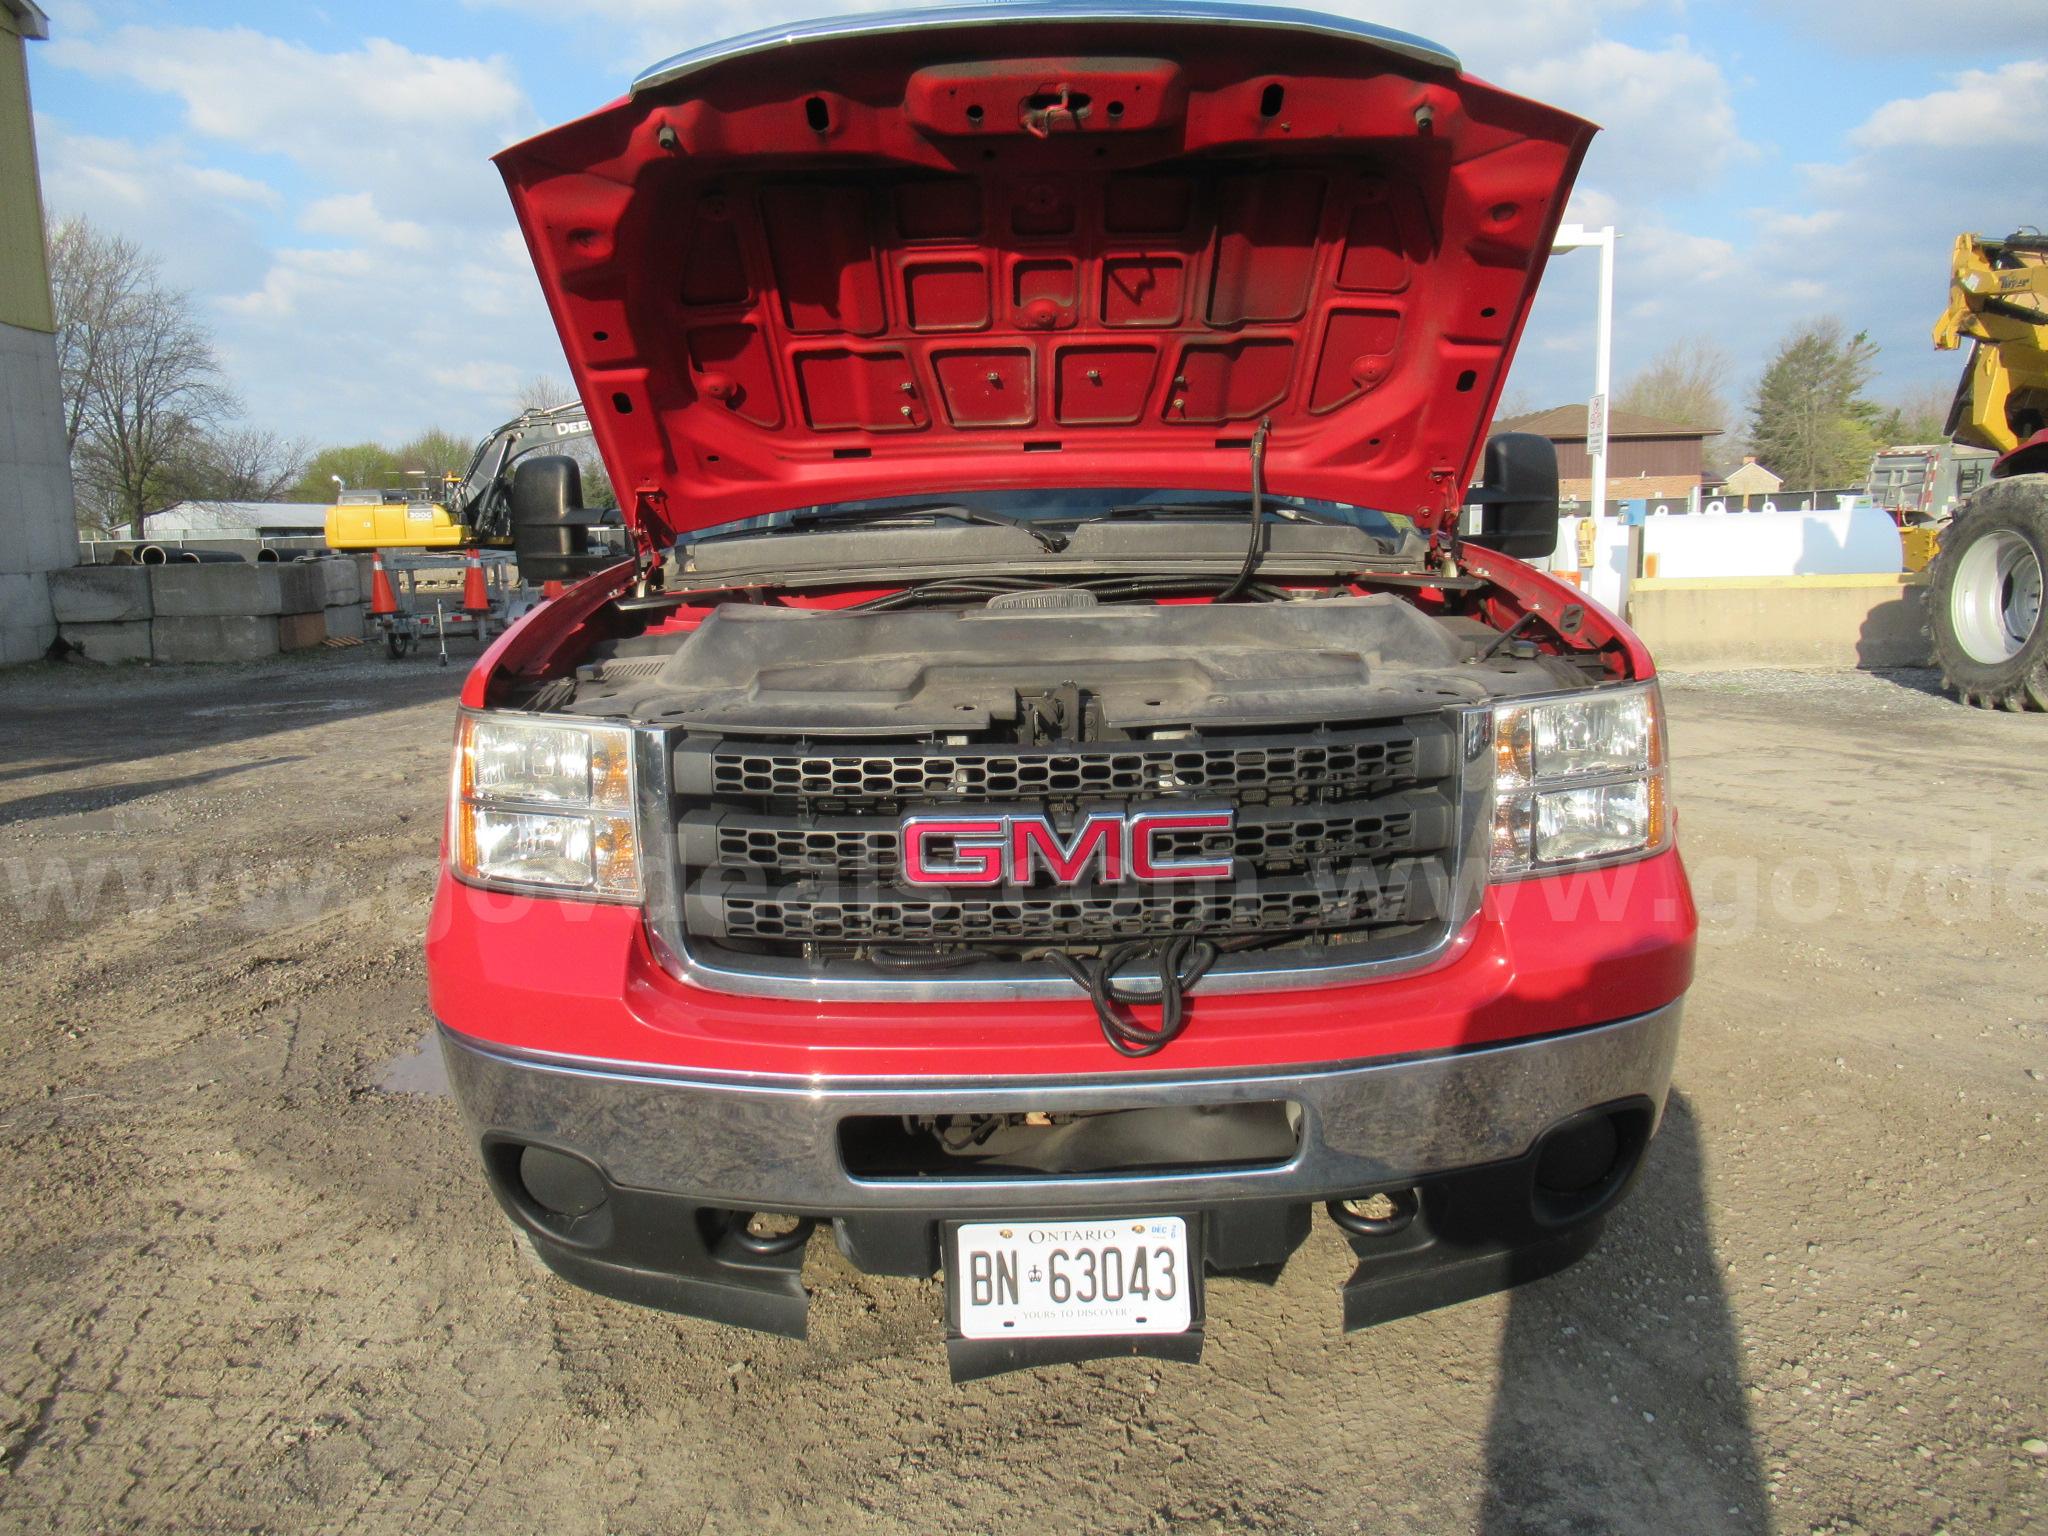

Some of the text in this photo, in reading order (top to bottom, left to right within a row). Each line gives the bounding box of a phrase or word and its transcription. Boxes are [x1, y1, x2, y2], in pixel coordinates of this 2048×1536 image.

[556, 420, 592, 435] DEE
[901, 810, 1235, 888] GMC
[1028, 1229, 1117, 1244] ONTARIO
[1151, 1225, 1167, 1234] DEC
[970, 1246, 1177, 1306] BN 63043
[1023, 1307, 1128, 1320] YOURS TO DISCOVER
